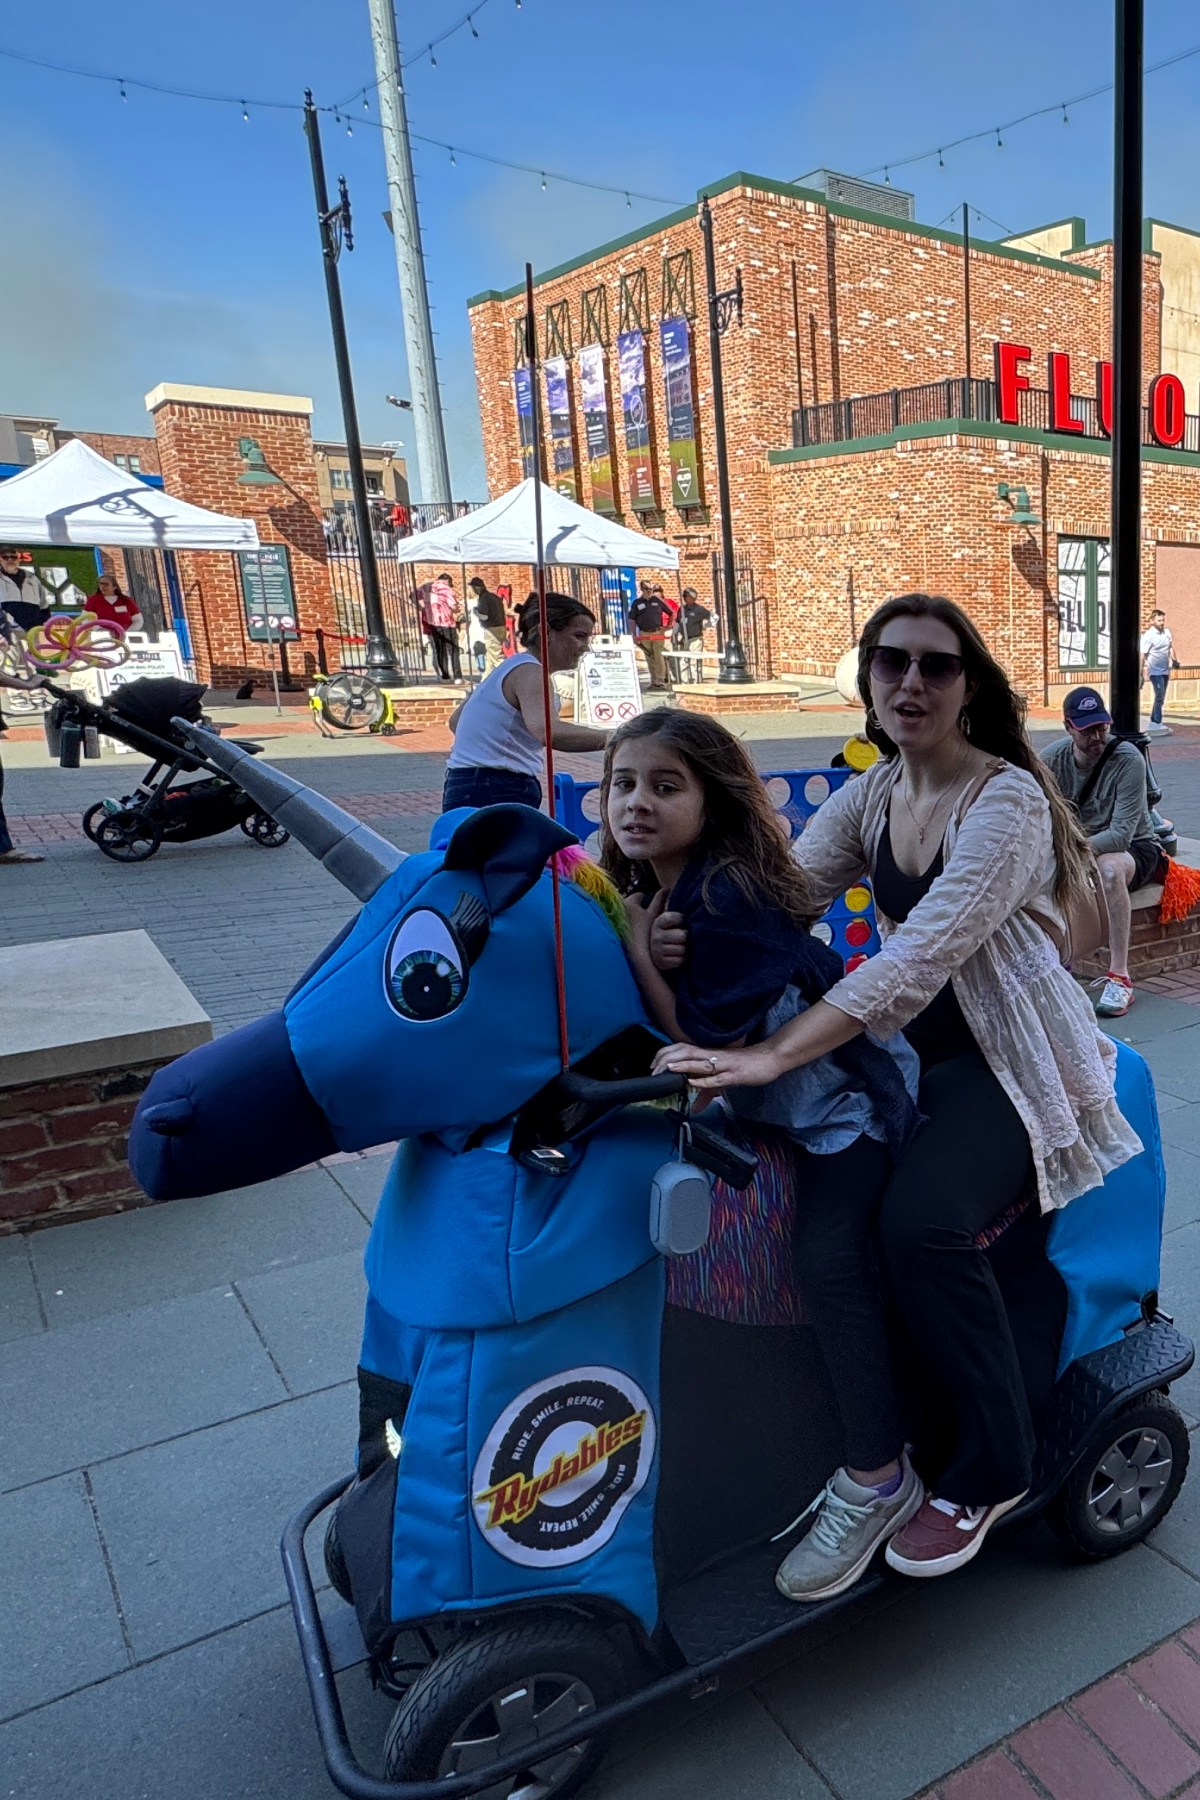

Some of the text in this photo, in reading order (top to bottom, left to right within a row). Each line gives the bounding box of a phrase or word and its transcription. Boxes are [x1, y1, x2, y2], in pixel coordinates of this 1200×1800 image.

[511, 1395, 605, 1461] RIDE. SMILE. REPEAT.
[477, 1412, 645, 1527] Rydables
[539, 1517, 579, 1533] REPEAT.
